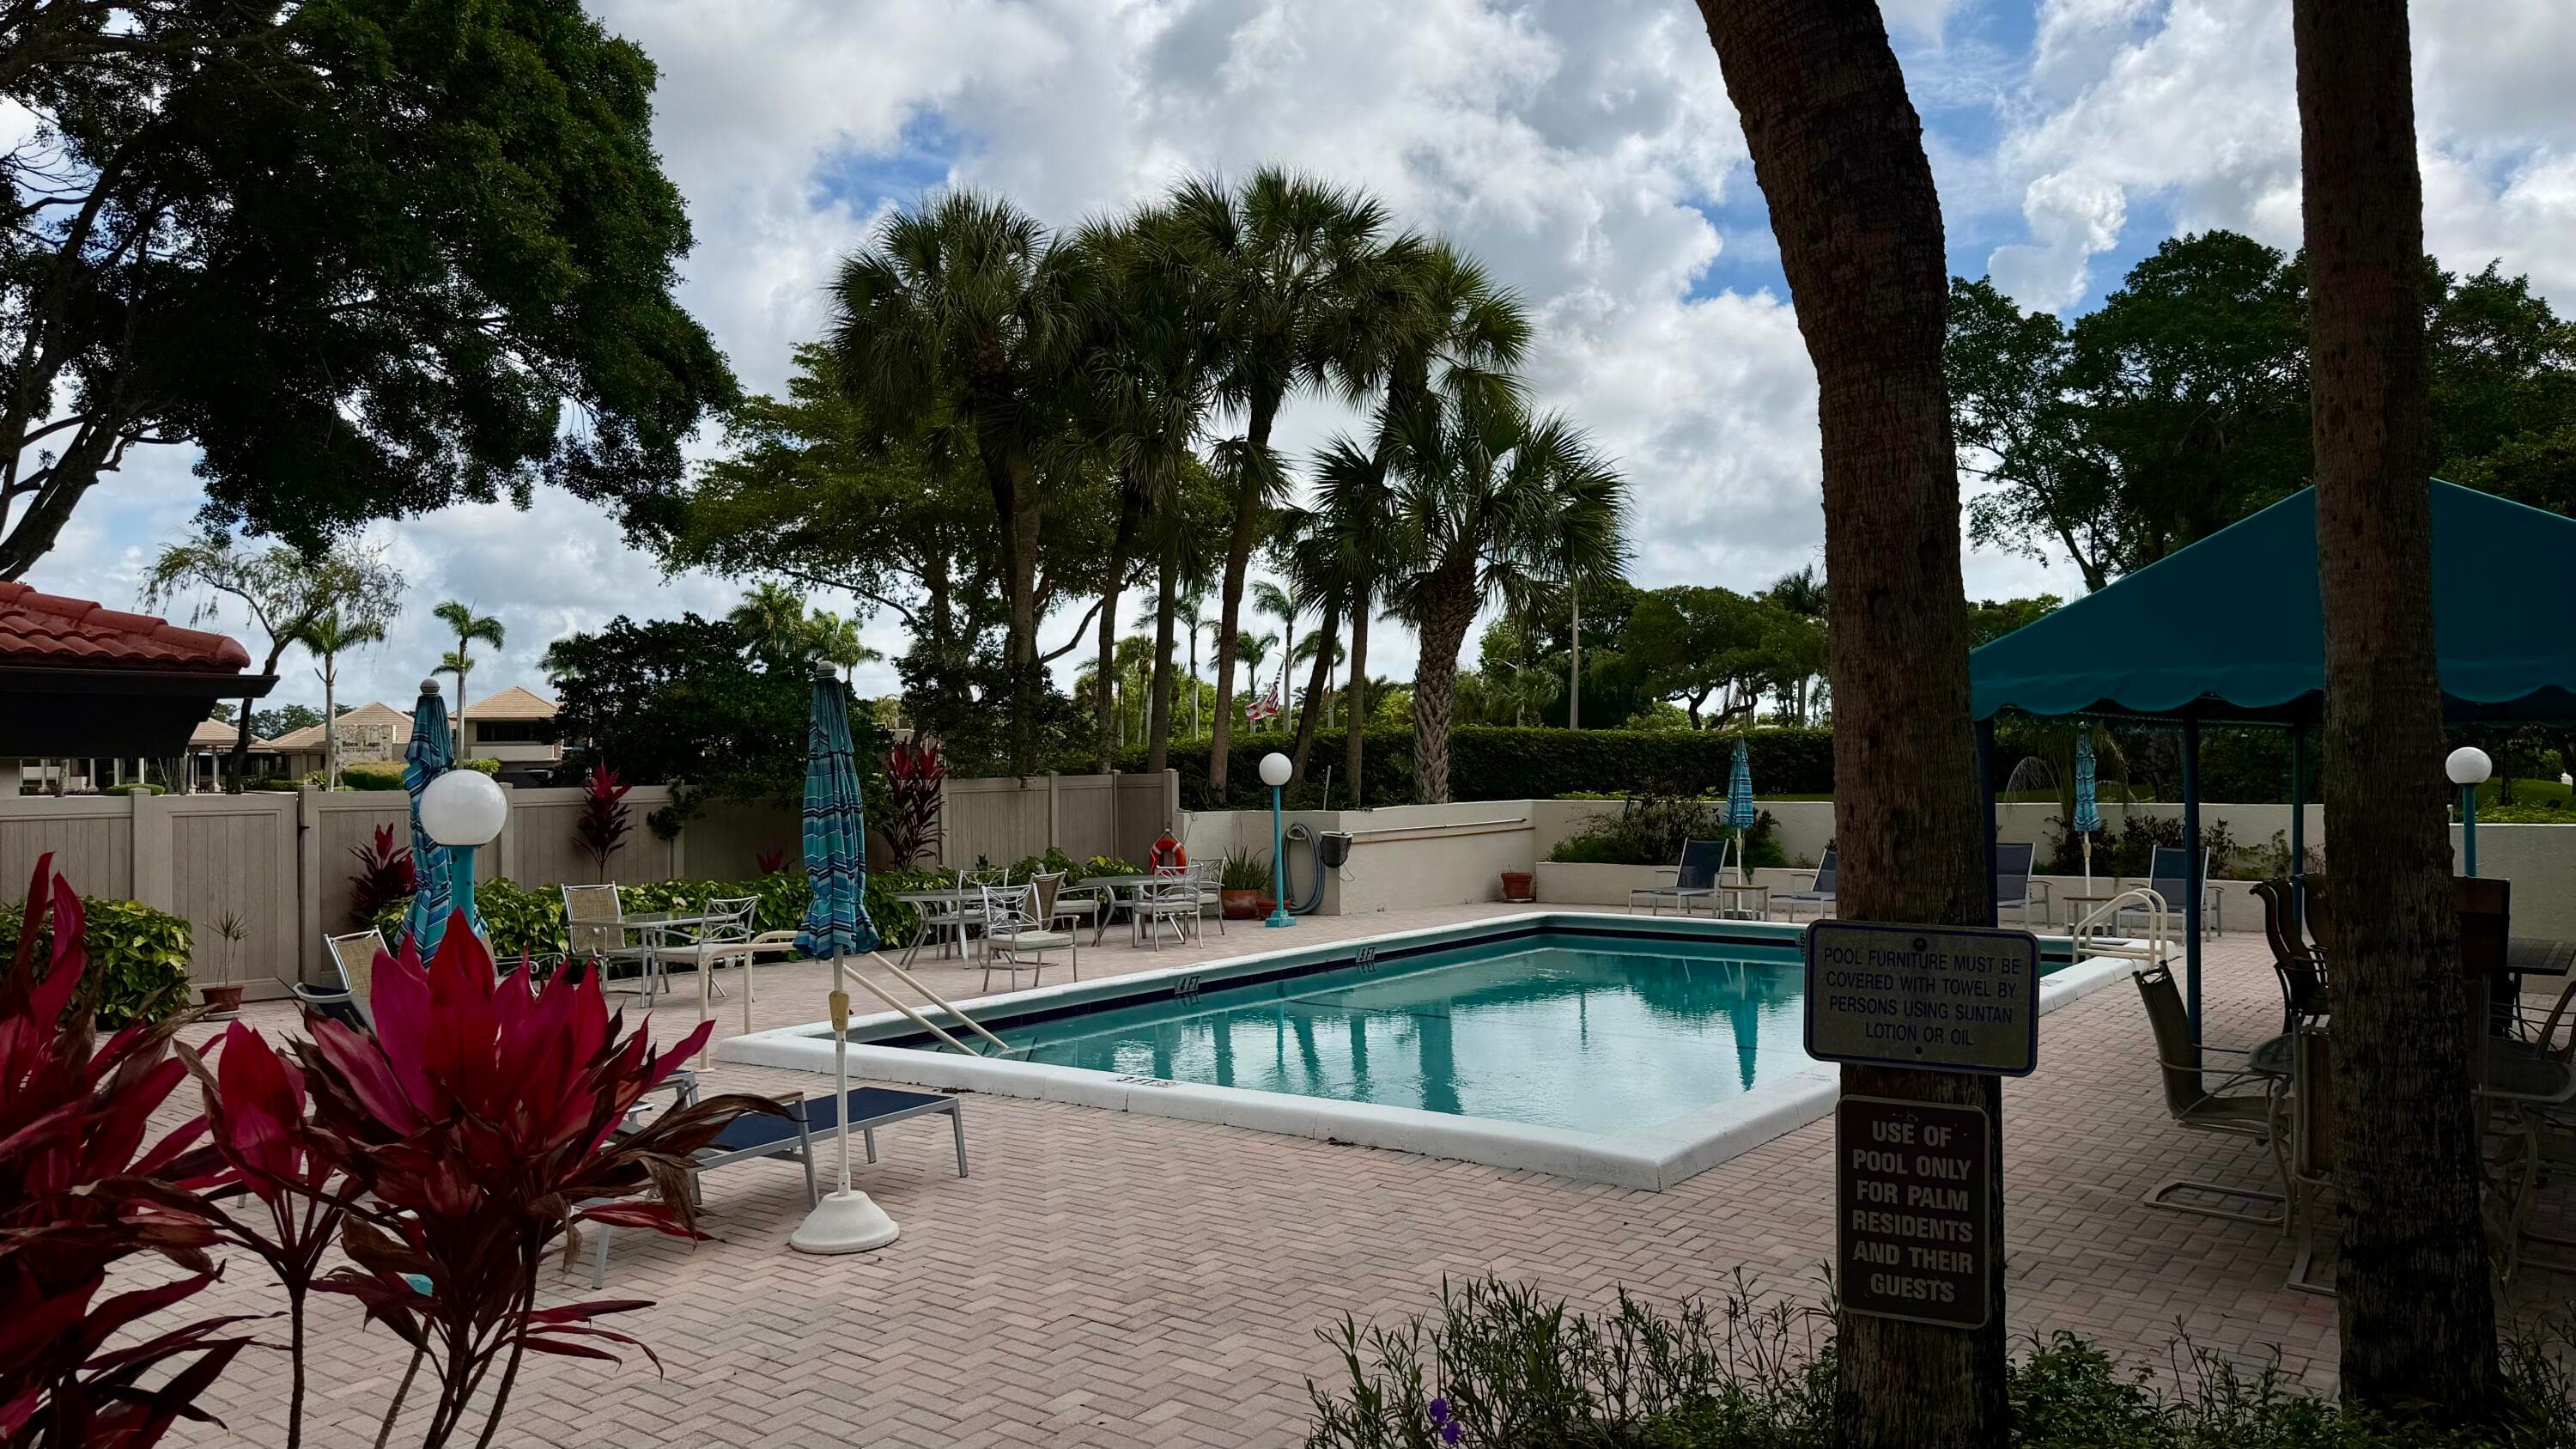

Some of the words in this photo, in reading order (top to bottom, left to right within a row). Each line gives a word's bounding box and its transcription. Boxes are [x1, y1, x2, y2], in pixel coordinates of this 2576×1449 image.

[1359, 948, 1366, 961] 5
[1365, 947, 1376, 961] FT
[1824, 947, 1862, 965] POOL
[1868, 950, 1947, 971] FURNITURE
[1953, 955, 1996, 973] MUST
[2002, 958, 2020, 975] BE
[1179, 977, 1187, 991] 4
[1187, 975, 1201, 990] FT
[1826, 971, 1893, 990] COVERED
[1899, 975, 1935, 994] WITH
[1942, 978, 1992, 997] TOWEL
[1997, 982, 2017, 998] BY
[1830, 995, 1898, 1015] PERSONS
[1904, 1001, 1948, 1020] USING
[1954, 1003, 2013, 1023] SUNTAN
[1865, 1022, 1917, 1041] LOTION
[1923, 1026, 1944, 1044] OR
[1950, 1028, 1973, 1045] OIL
[1872, 1120, 1915, 1144] USE
[1923, 1125, 1952, 1148] OF
[1852, 1148, 1908, 1175] POOL
[1916, 1155, 1972, 1181] ONLY
[1856, 1179, 1898, 1204] FOR
[1908, 1184, 1968, 1212] PALM
[1852, 1209, 1973, 1243] RESIDENTS
[1852, 1240, 1900, 1265] AND
[1908, 1246, 1973, 1274] THEIR
[1870, 1272, 1954, 1303] GUESTS
